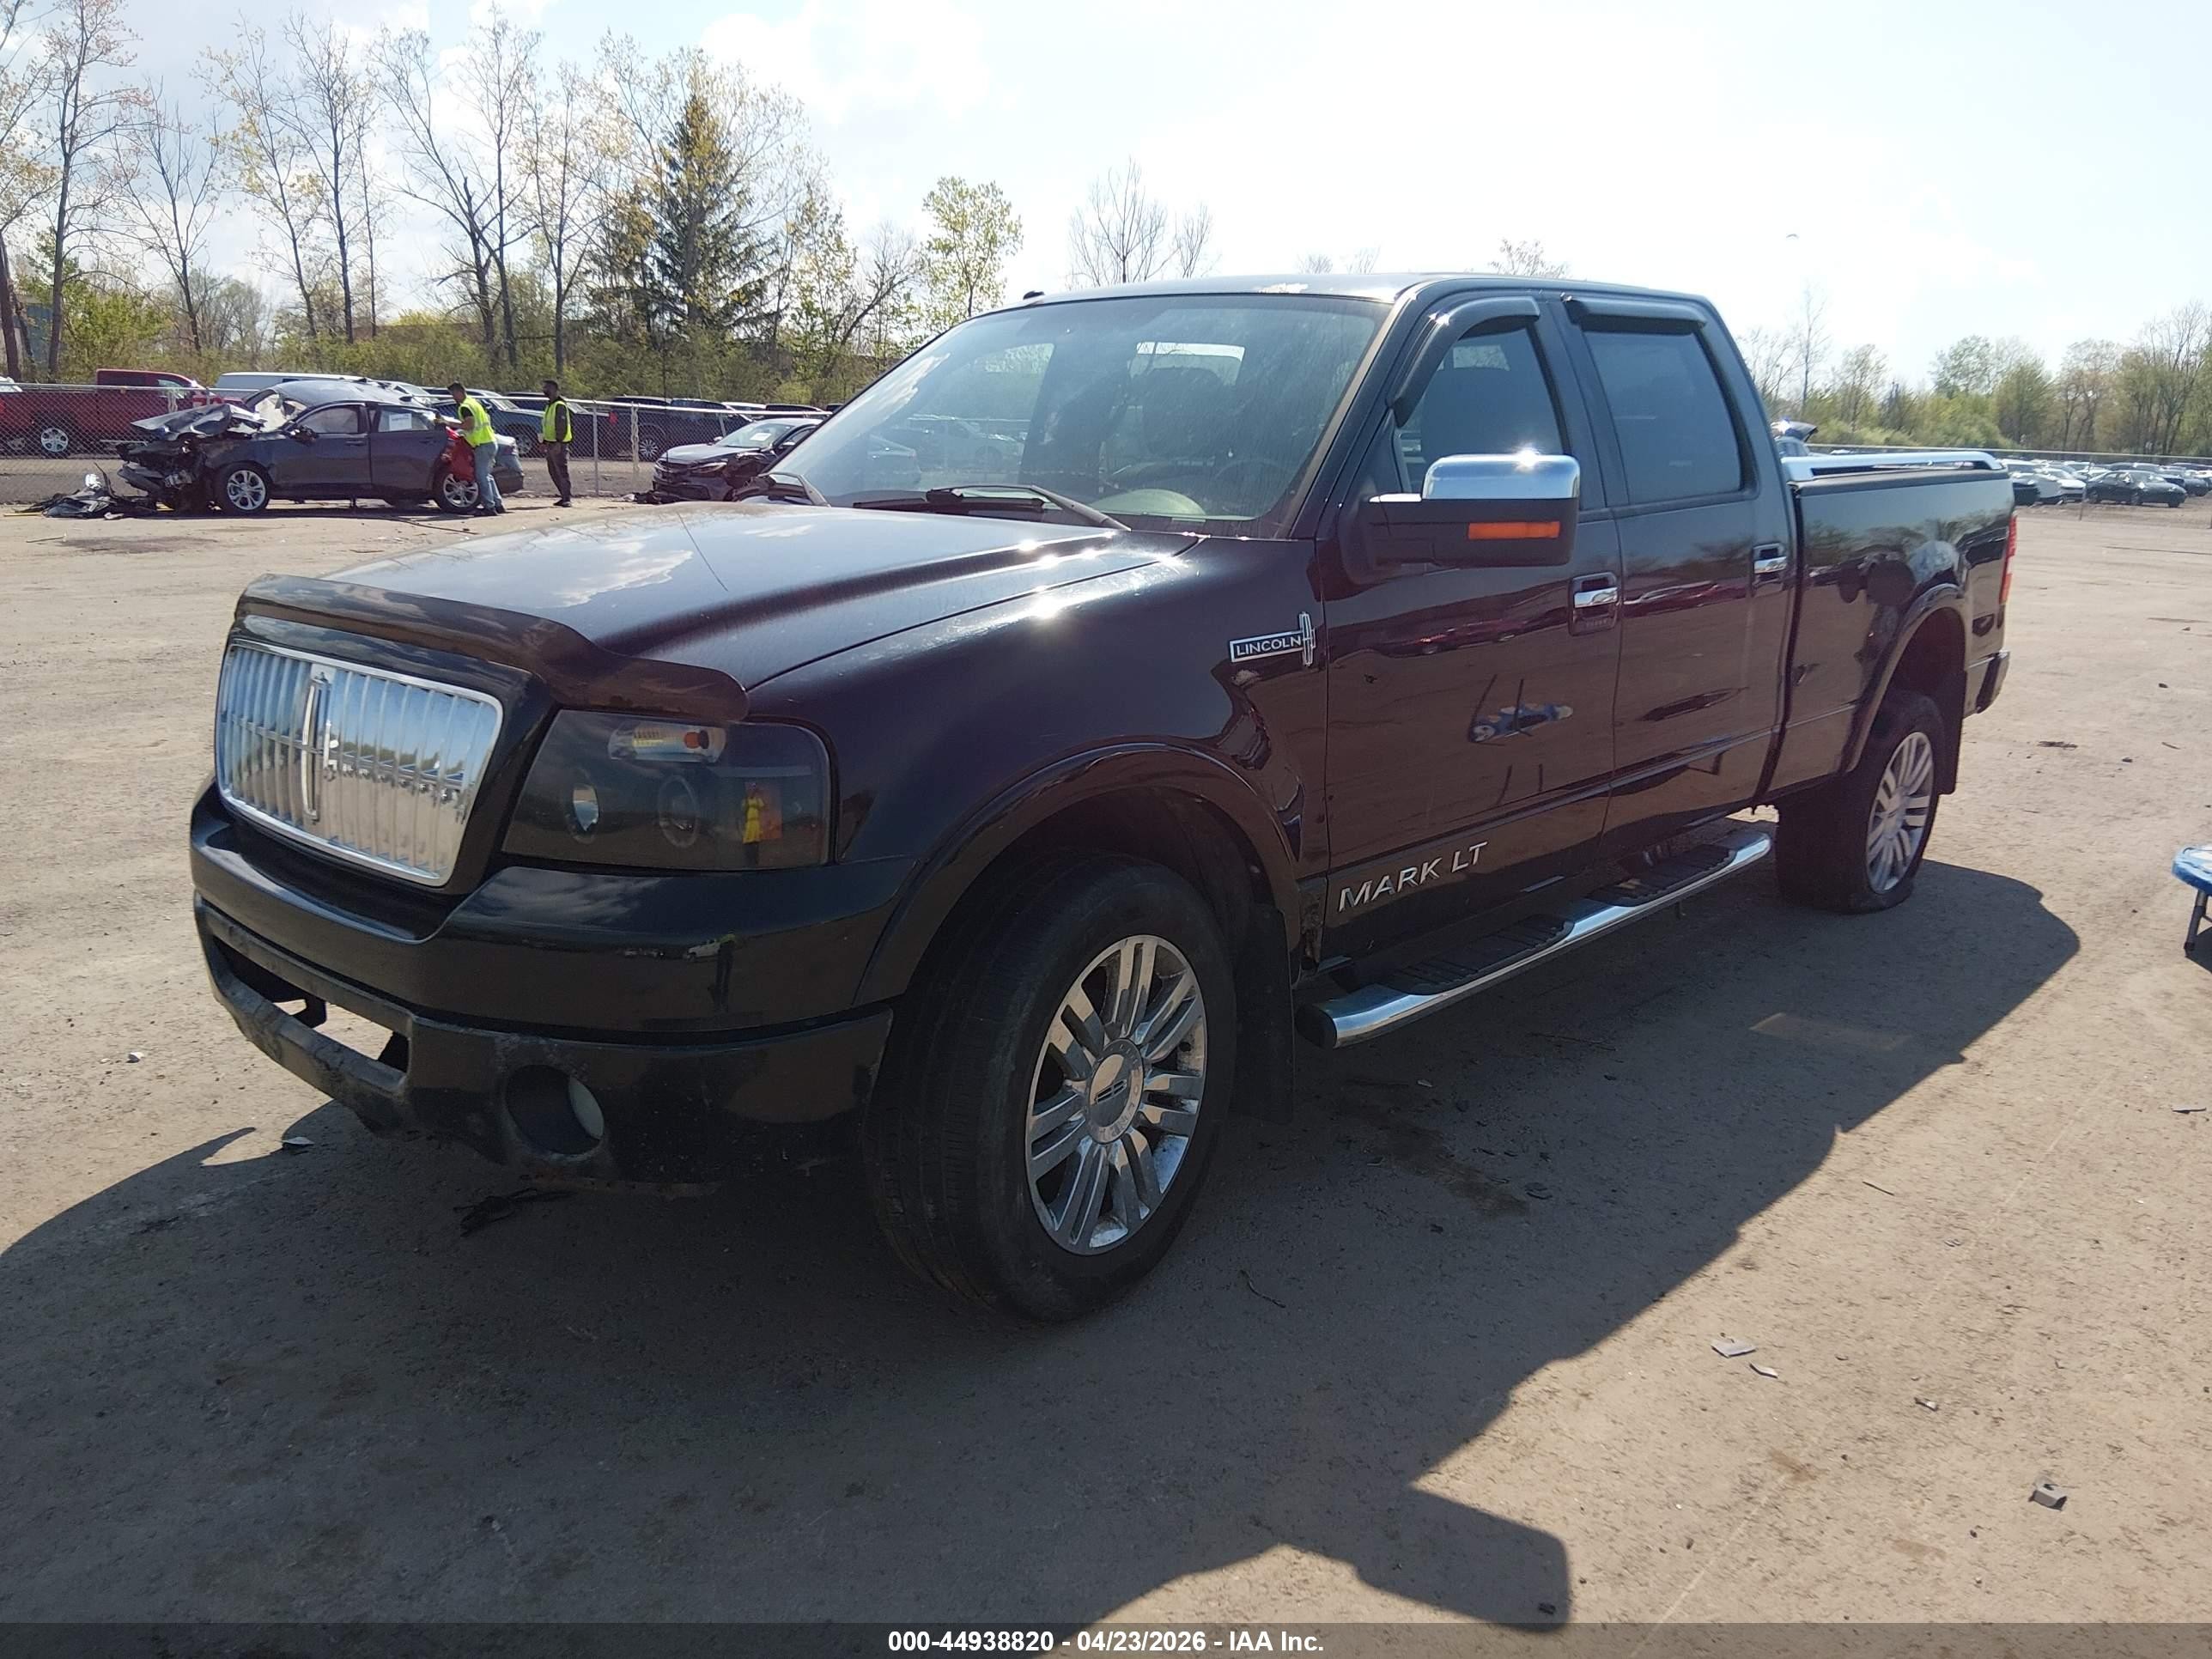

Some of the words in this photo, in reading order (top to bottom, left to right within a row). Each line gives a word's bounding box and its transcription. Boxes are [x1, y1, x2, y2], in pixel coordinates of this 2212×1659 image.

[1237, 635, 1302, 656] LINCOLN
[1338, 857, 1443, 912] MARK
[1451, 841, 1489, 873] LT
